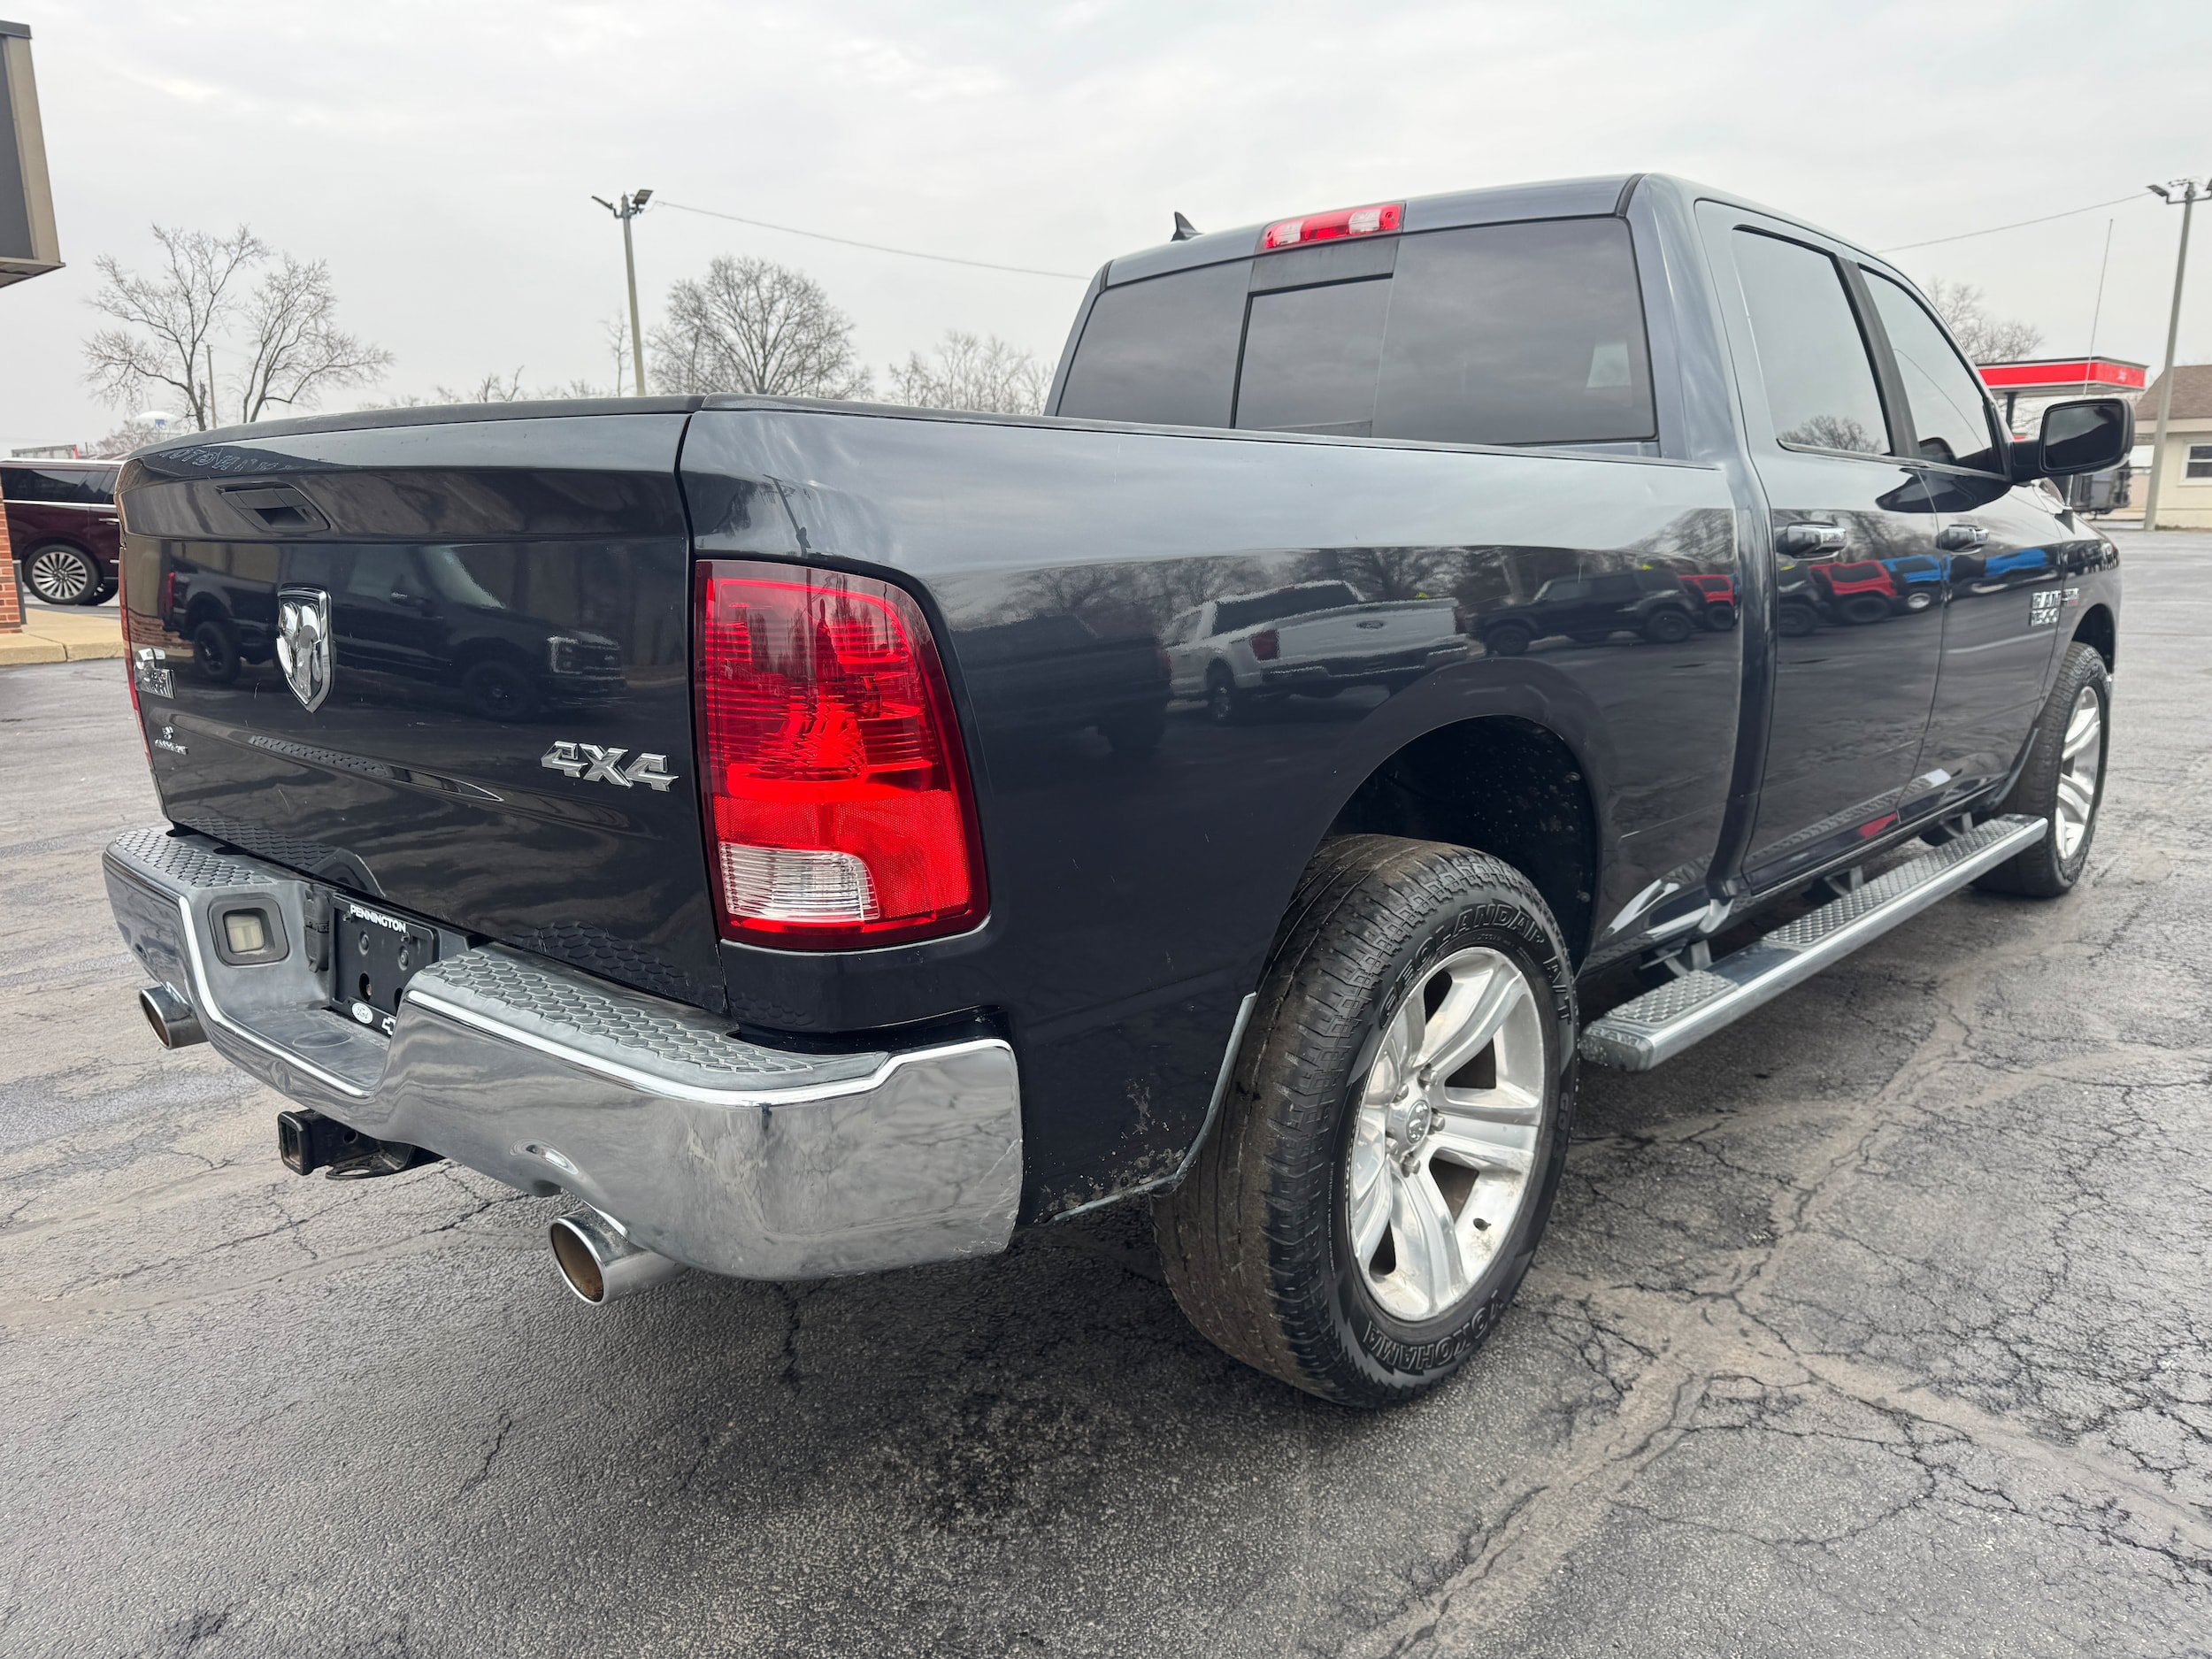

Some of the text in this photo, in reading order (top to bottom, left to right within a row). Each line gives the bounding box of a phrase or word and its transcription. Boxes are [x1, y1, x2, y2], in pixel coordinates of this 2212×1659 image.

[350, 904, 407, 933] PENNINGTON
[1379, 903, 1545, 1029] GEOLANDAR
[1363, 1289, 1504, 1371] YOKOHAMA
